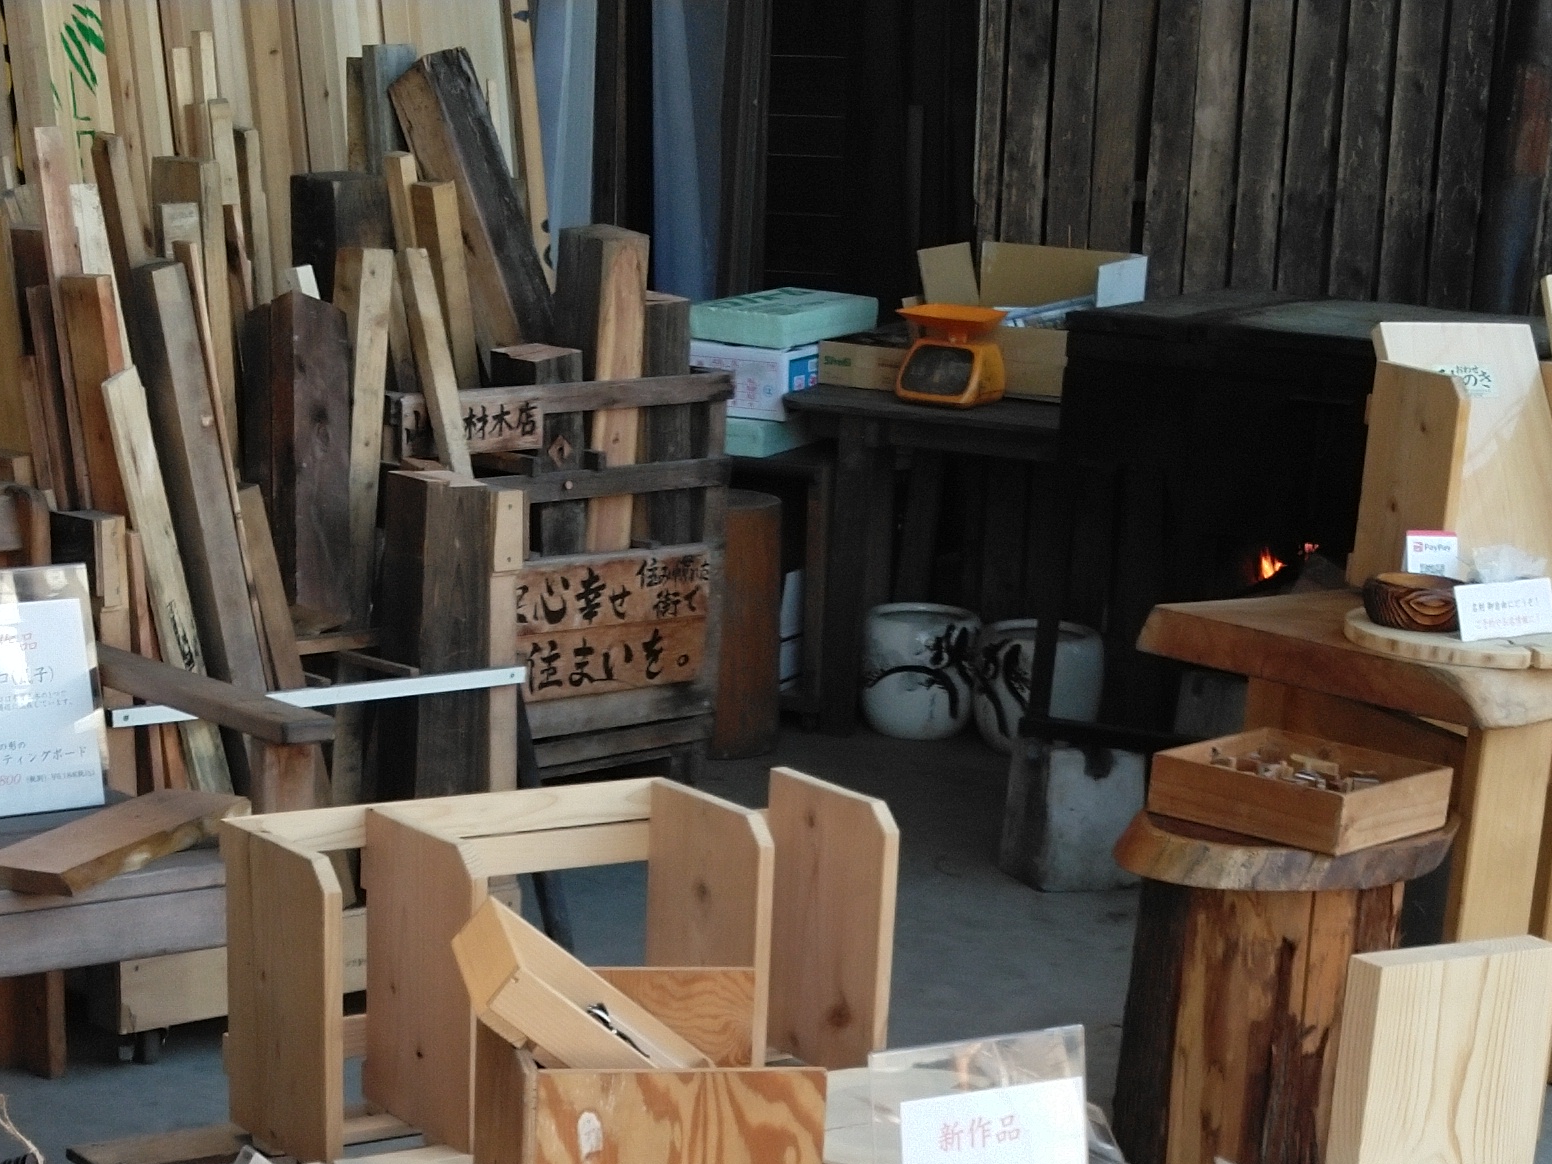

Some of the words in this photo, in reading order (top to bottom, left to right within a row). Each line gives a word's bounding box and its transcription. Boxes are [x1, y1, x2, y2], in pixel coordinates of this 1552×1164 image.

[1424, 543, 1451, 552] PayPay
[528, 628, 690, 696] 住まいを。
[938, 1114, 1022, 1152] 新作品
